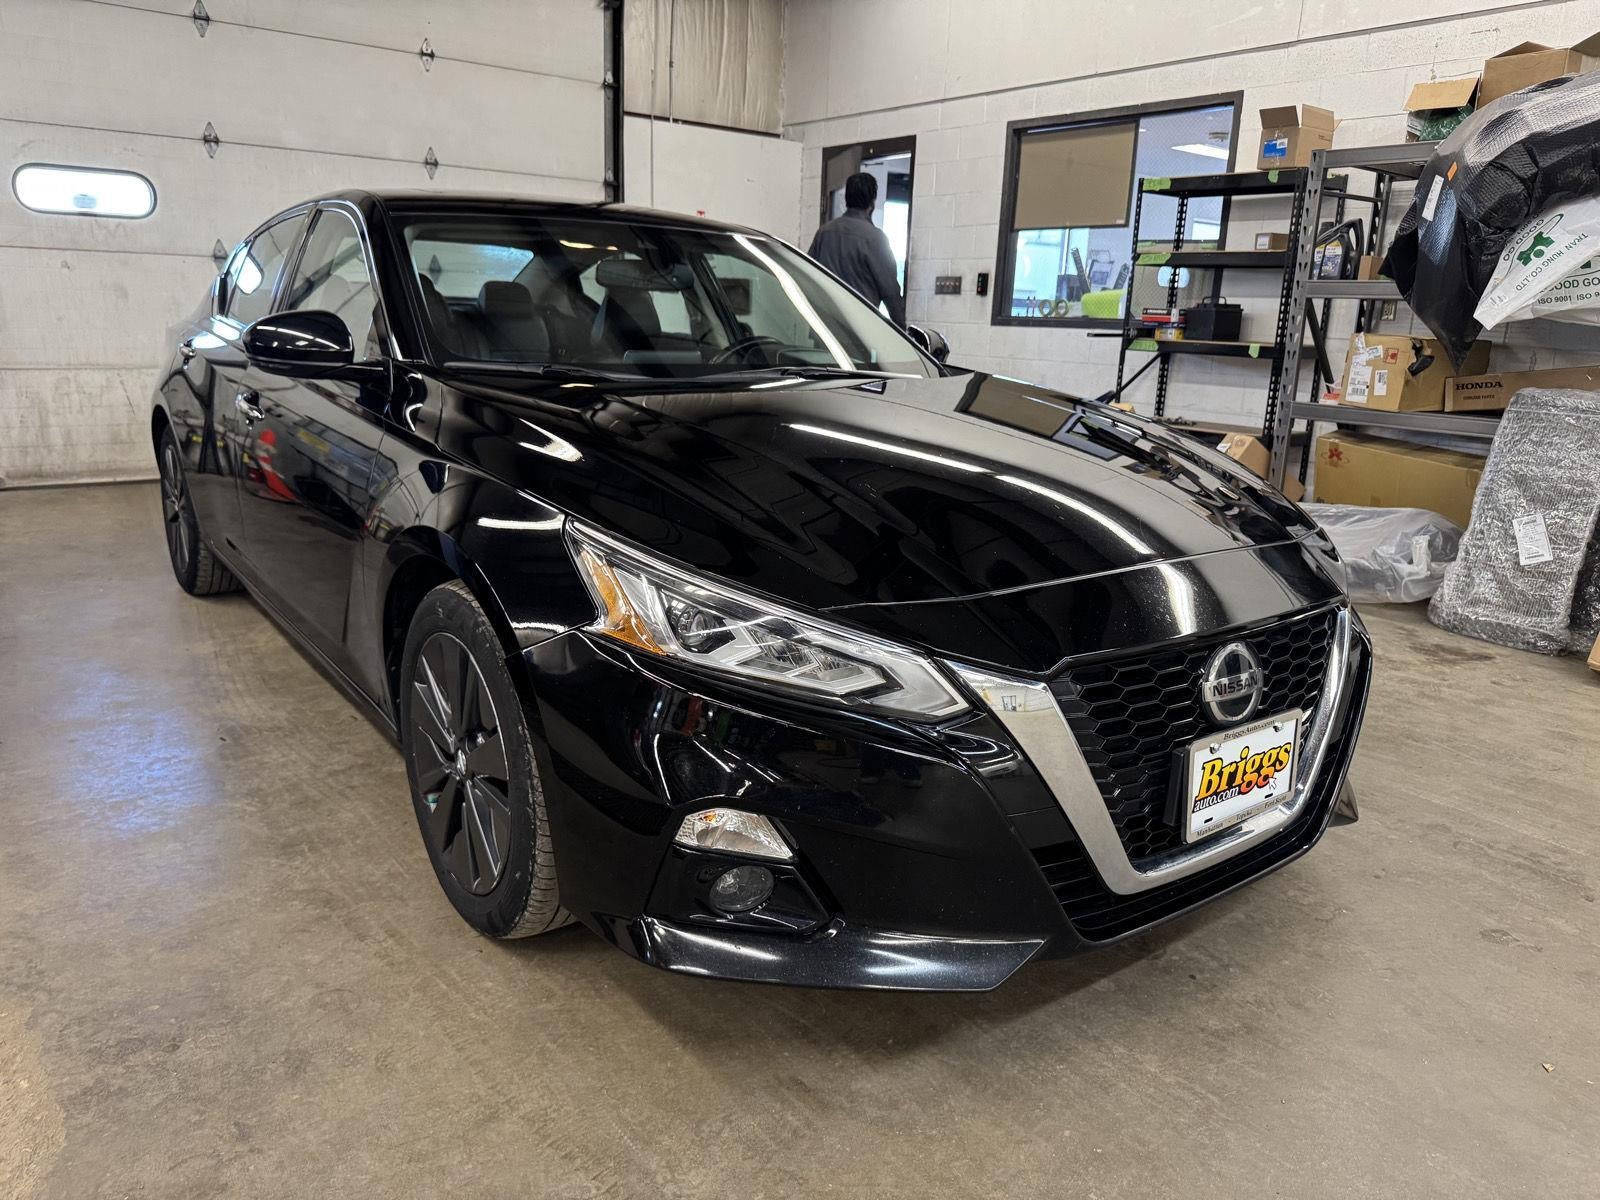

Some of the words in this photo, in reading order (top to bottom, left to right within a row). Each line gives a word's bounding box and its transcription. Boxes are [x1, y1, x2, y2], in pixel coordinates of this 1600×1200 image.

[1516, 219, 1544, 245] GOOD
[1564, 232, 1588, 251] TRAN
[1542, 249, 1564, 267] HUNG
[1549, 279, 1579, 291] OOD
[1537, 296, 1553, 304] ISO
[1576, 292, 1592, 300] ISO
[1456, 381, 1504, 391] HONDA
[1212, 674, 1258, 697] NISSAN
[1196, 743, 1292, 800] Briggs
